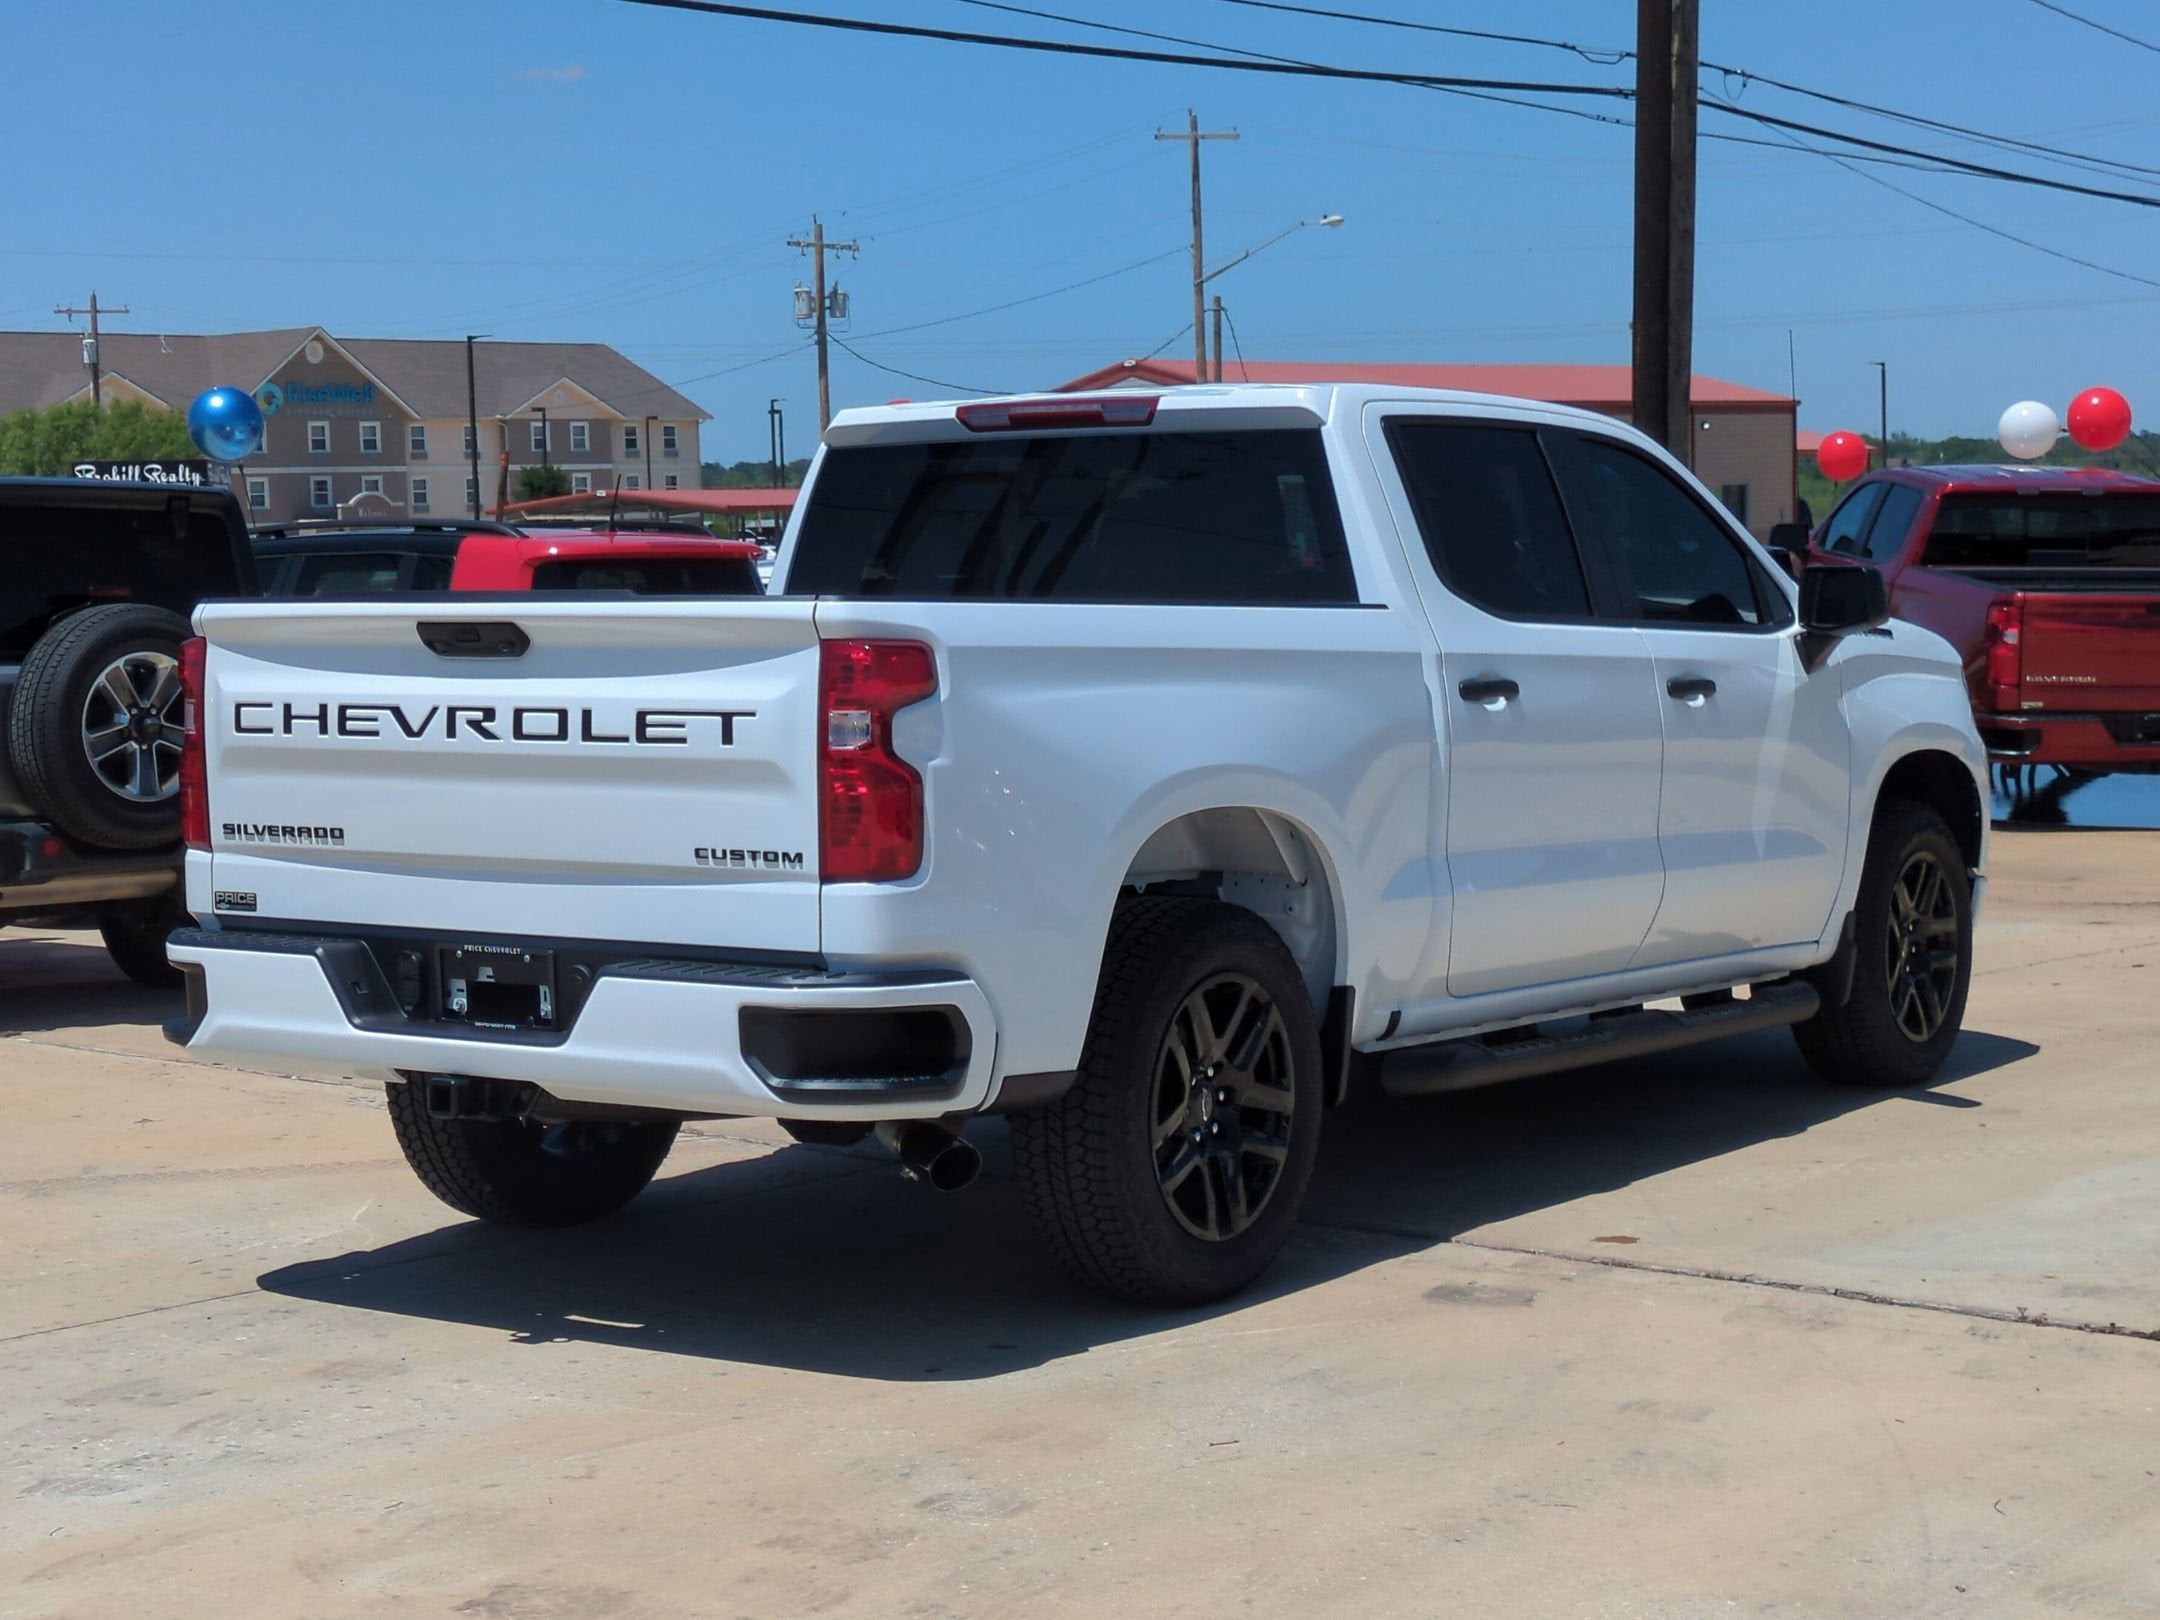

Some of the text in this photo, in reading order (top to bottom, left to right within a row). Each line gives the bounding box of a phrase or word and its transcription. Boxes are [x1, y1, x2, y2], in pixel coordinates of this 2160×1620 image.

[143, 463, 200, 487] Realty
[234, 702, 757, 746] CHEVROLET
[222, 823, 345, 840] SILVERADO
[694, 847, 804, 864] CUSTOM
[215, 892, 256, 904] PRICE
